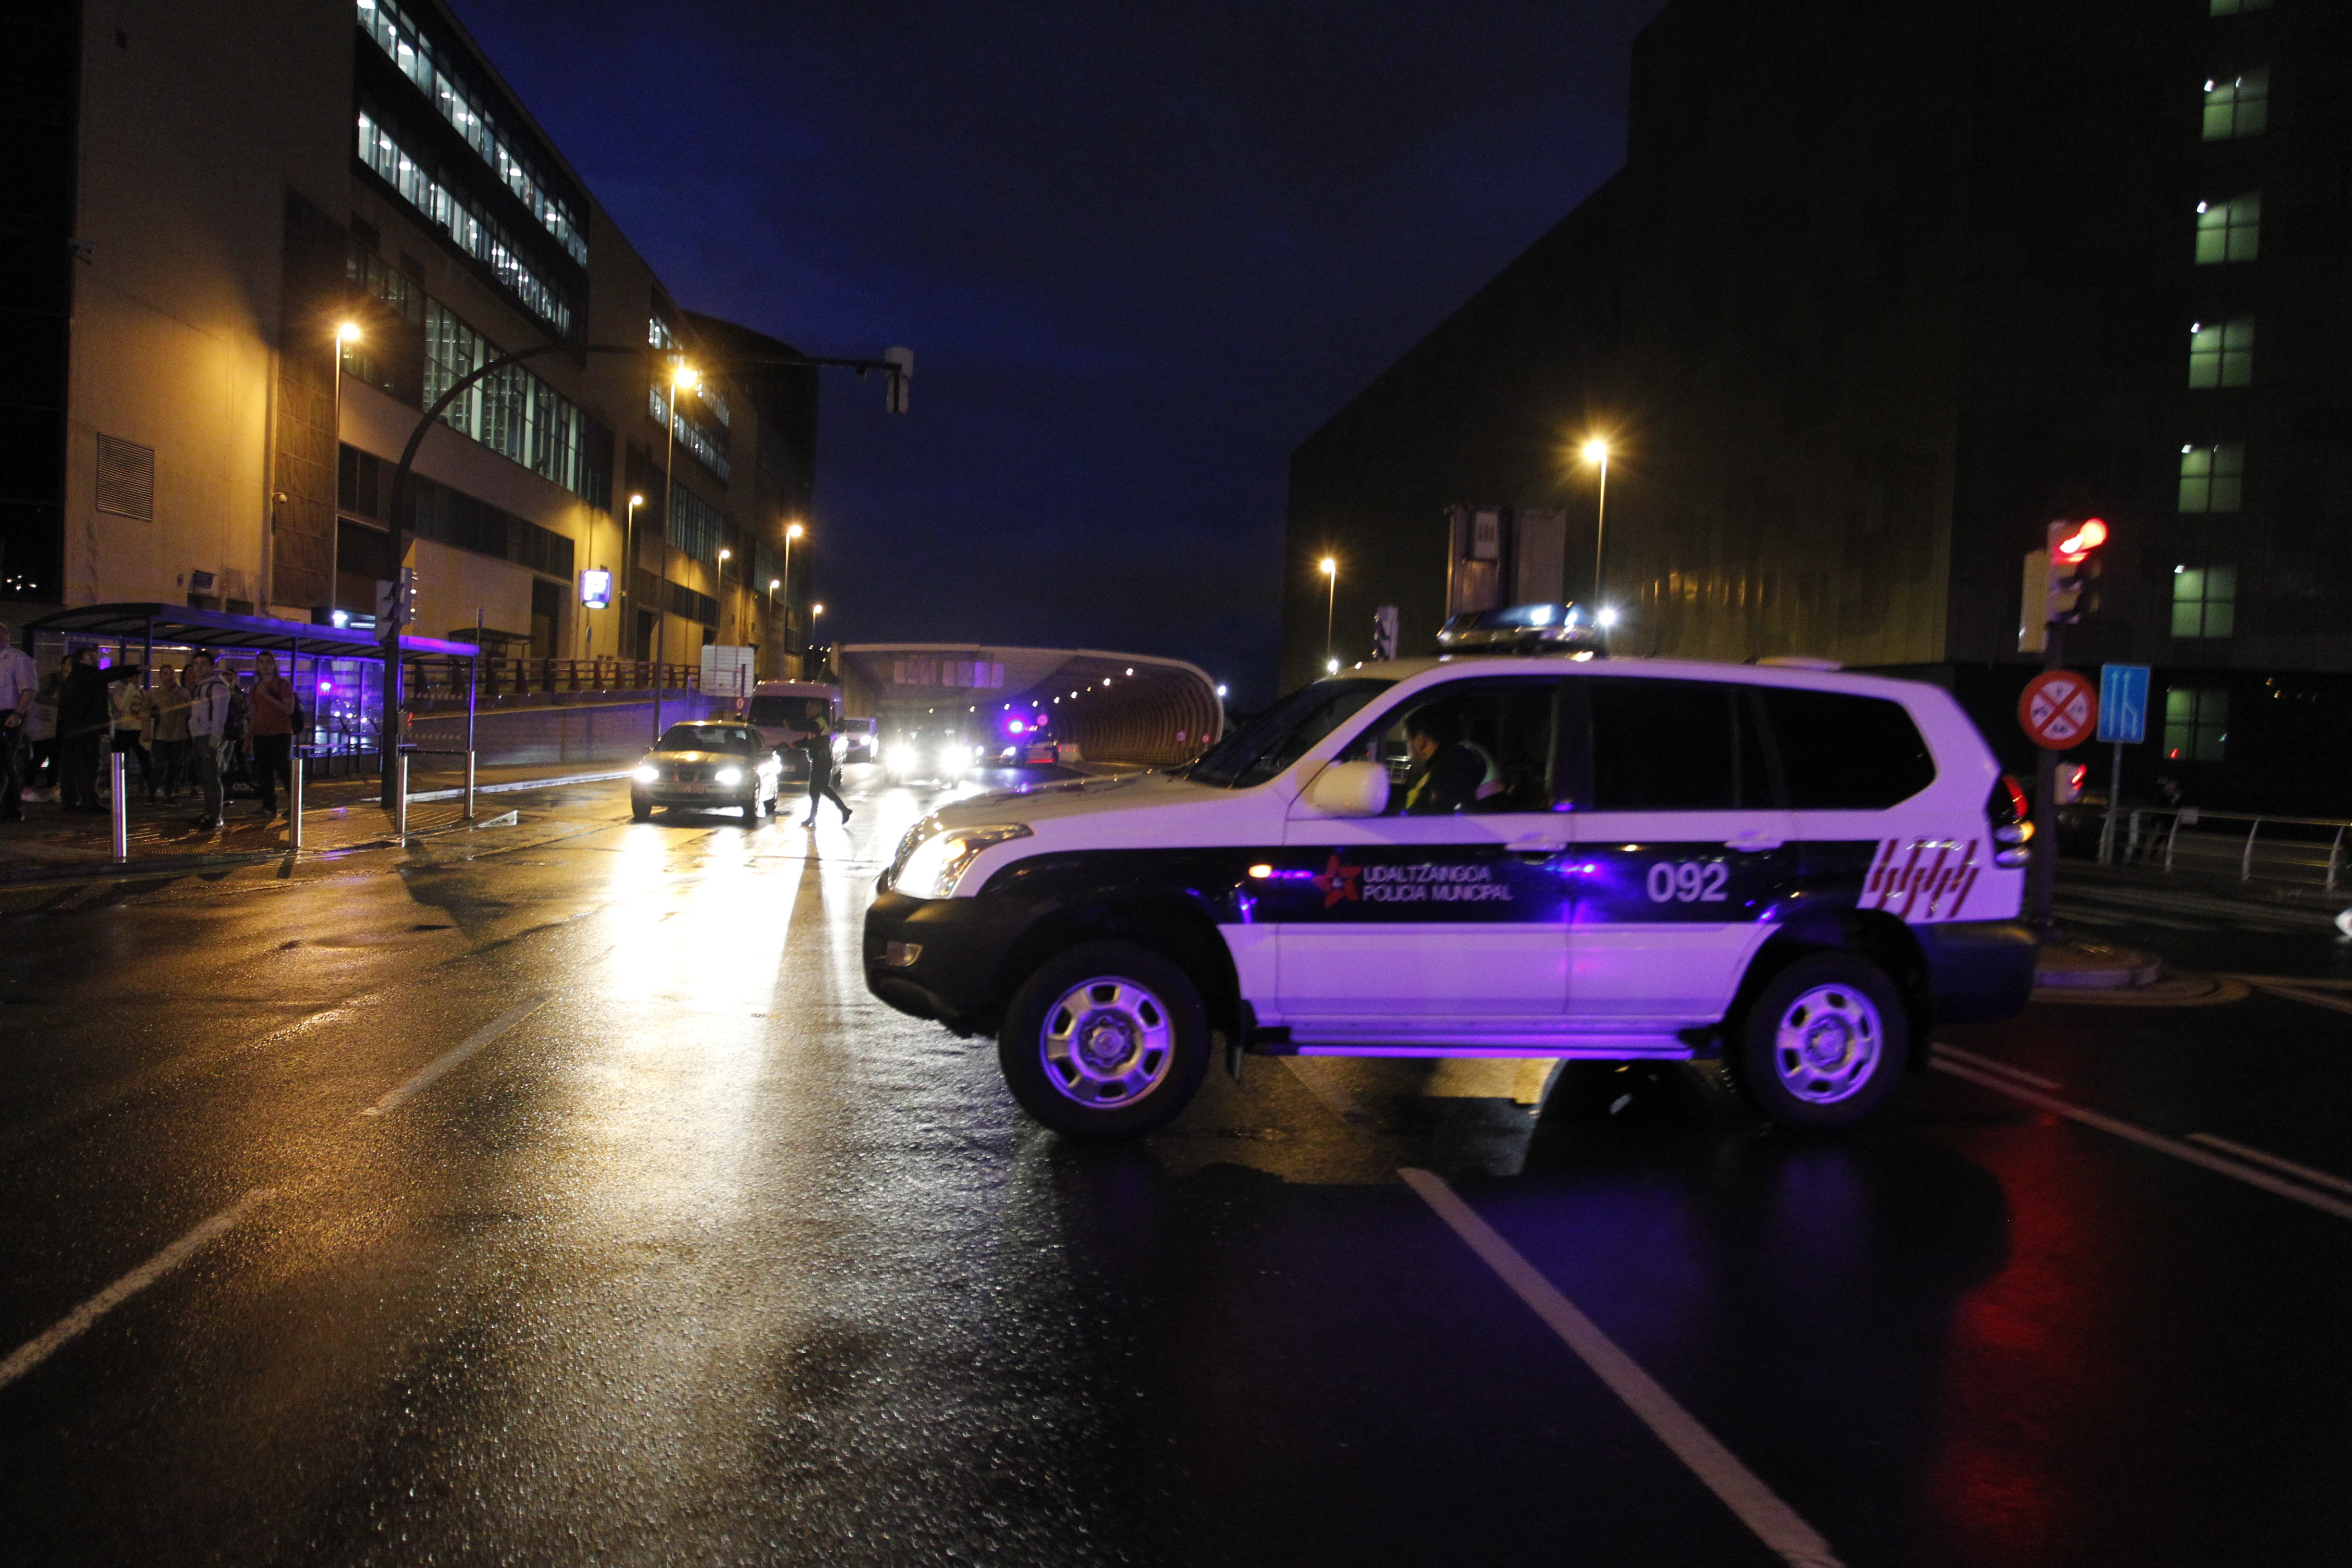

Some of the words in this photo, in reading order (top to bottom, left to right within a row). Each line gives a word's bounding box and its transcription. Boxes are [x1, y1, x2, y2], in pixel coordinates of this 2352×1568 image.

[584, 571, 609, 600] P
[1363, 866, 1491, 883] UDALTZANGOA
[1647, 861, 1729, 903] 092
[1363, 884, 1427, 901] POLICIA
[1431, 884, 1514, 901] MUNICIPAL
